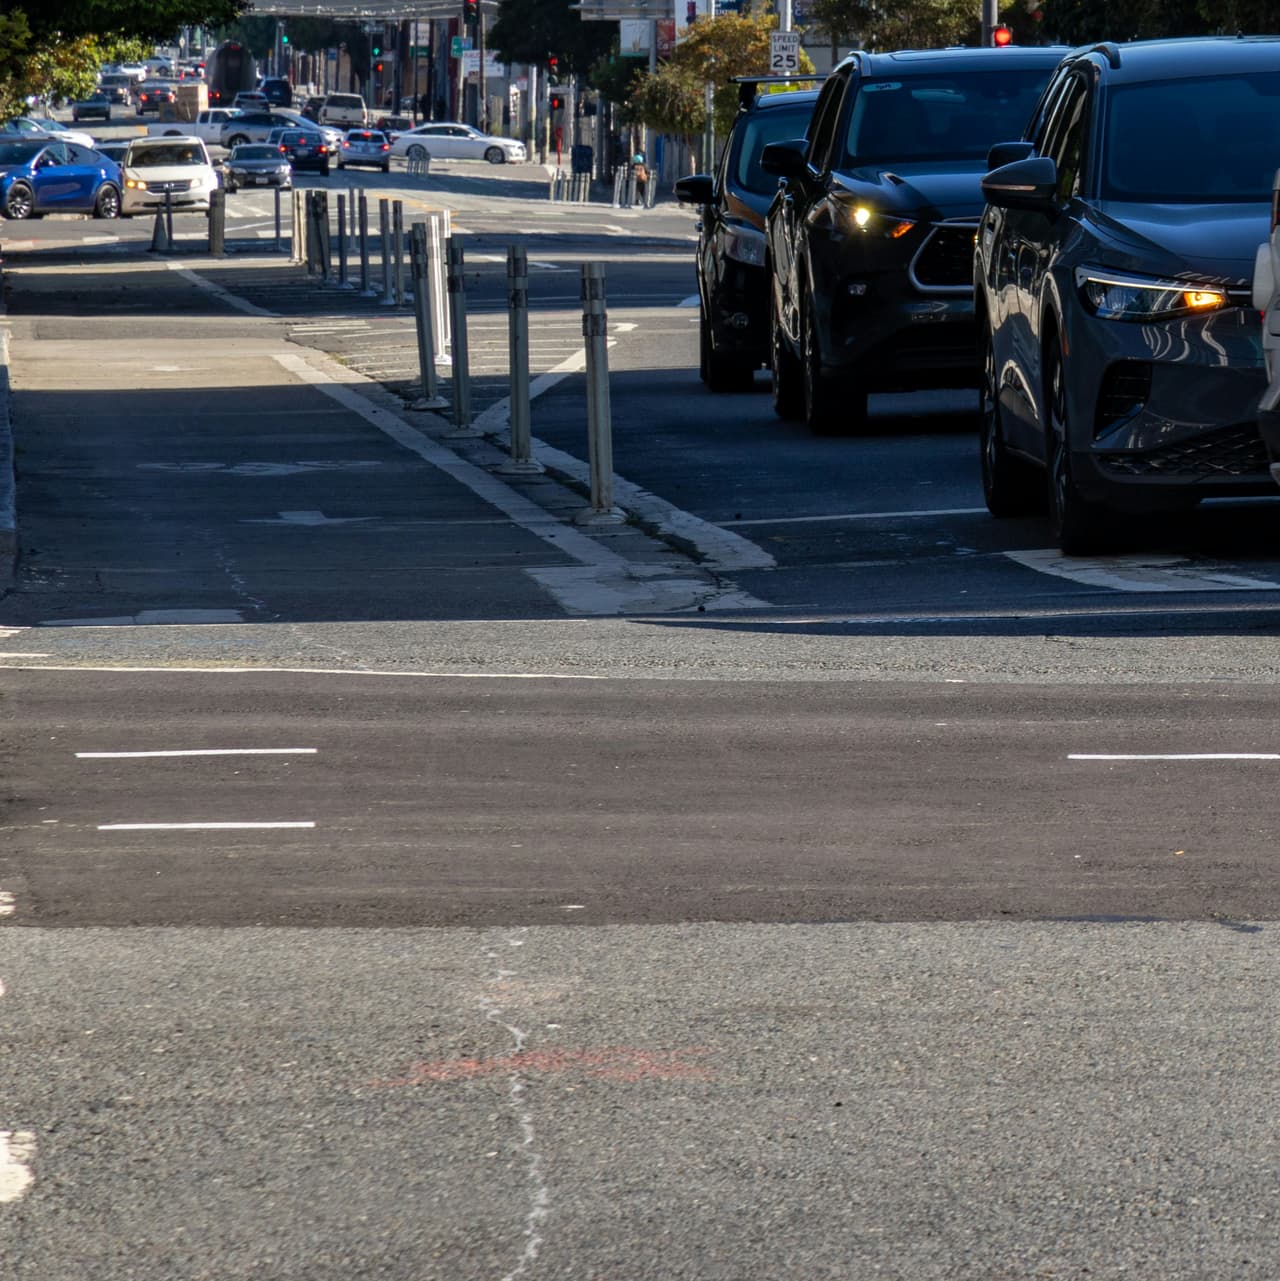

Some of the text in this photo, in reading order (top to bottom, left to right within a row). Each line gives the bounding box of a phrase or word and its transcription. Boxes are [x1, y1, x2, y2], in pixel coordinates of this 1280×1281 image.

[773, 34, 798, 43] SPEED
[774, 44, 795, 53] LIMIT
[772, 54, 796, 69] 25
